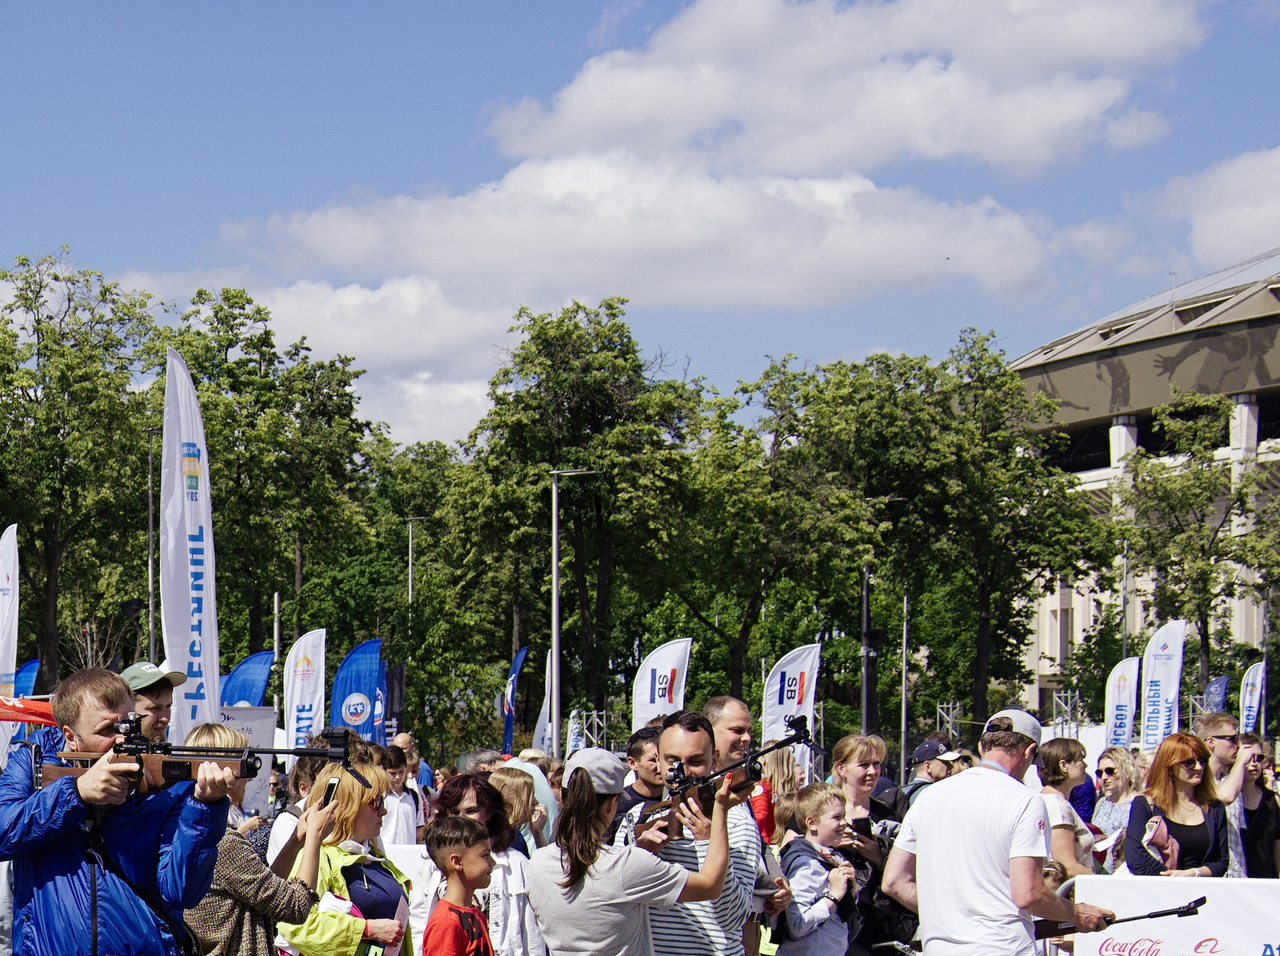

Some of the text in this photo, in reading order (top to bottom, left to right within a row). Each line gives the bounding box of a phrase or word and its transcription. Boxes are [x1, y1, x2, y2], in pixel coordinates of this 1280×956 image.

[658, 674, 669, 699] SB
[786, 677, 798, 700] SB
[1144, 679, 1162, 751] СТОЛЬНЫЙ
